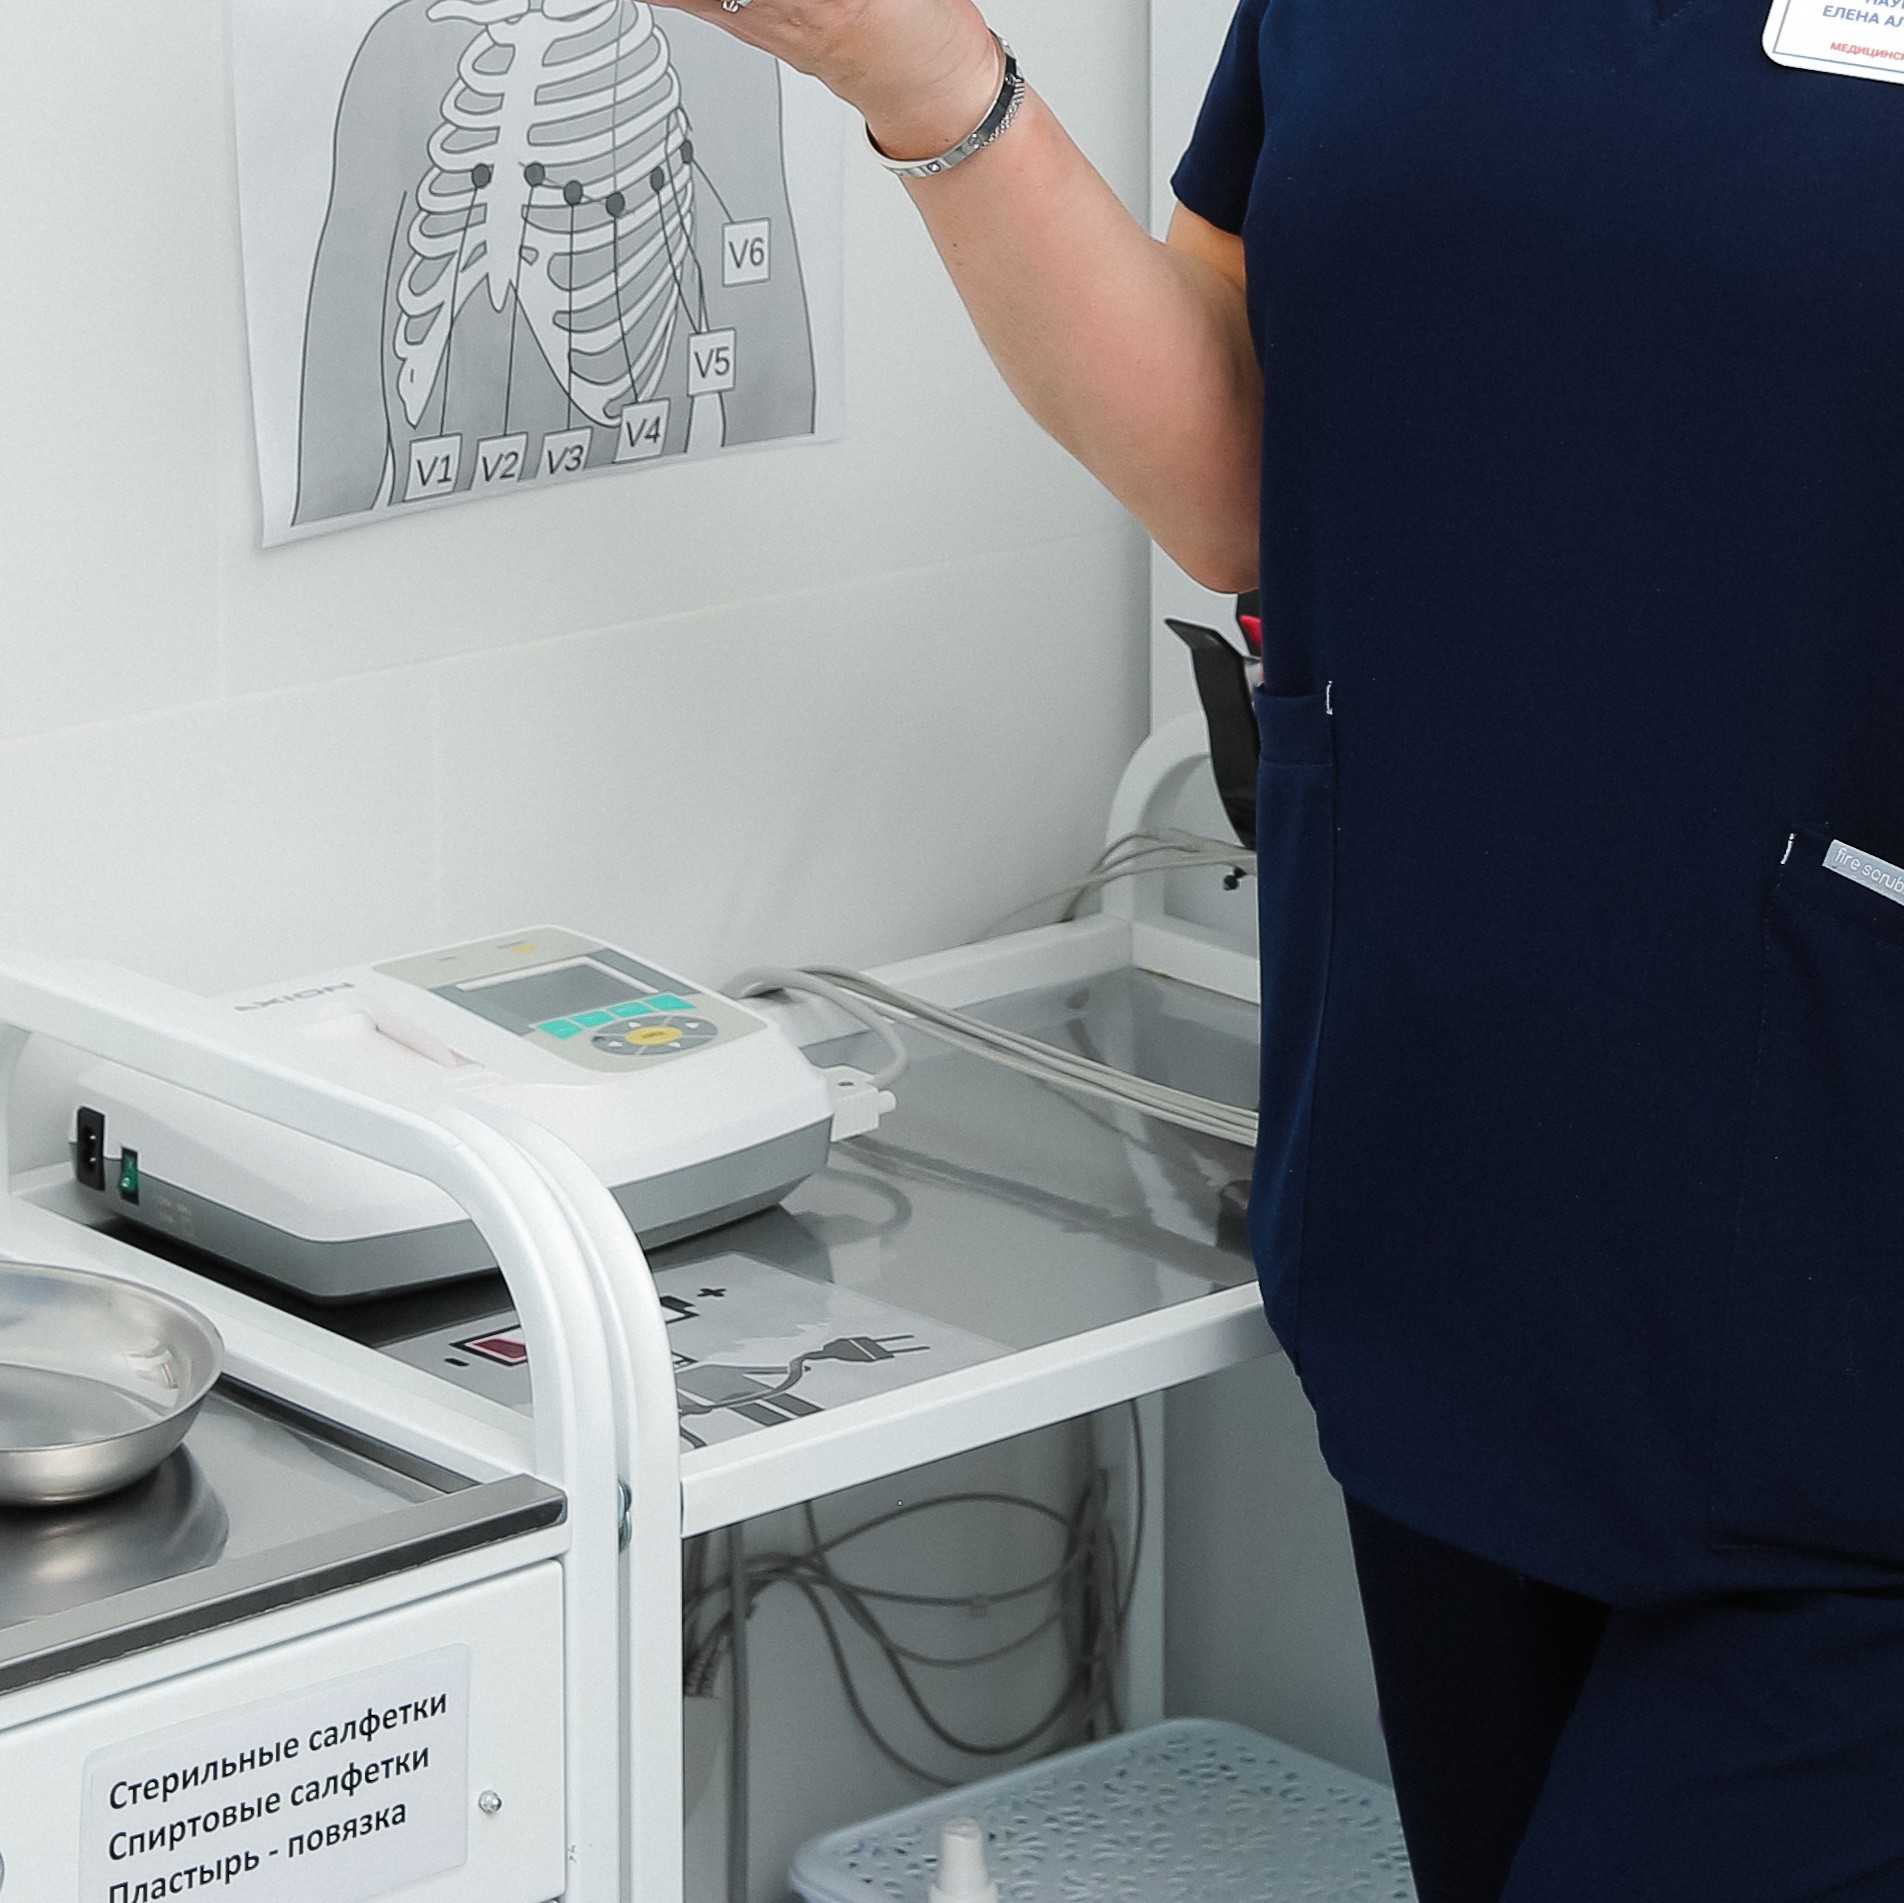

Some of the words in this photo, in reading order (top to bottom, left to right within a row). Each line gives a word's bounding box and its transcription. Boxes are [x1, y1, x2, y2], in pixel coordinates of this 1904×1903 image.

[1822, 5, 1880, 24] ЕЛЕНА
[728, 236, 766, 270] V6
[693, 345, 731, 380] V5
[626, 416, 662, 448] V4
[416, 455, 452, 487] V1
[481, 451, 520, 483] V2
[547, 444, 584, 475] V3
[1834, 847, 1861, 871] fire
[109, 1737, 300, 1810] Стерильные
[308, 1693, 448, 1752] салфетки
[108, 1791, 281, 1861] Спиртовые
[290, 1747, 430, 1807] салфетки
[108, 1850, 260, 1903] Пластырь
[287, 1802, 407, 1859] повязка
